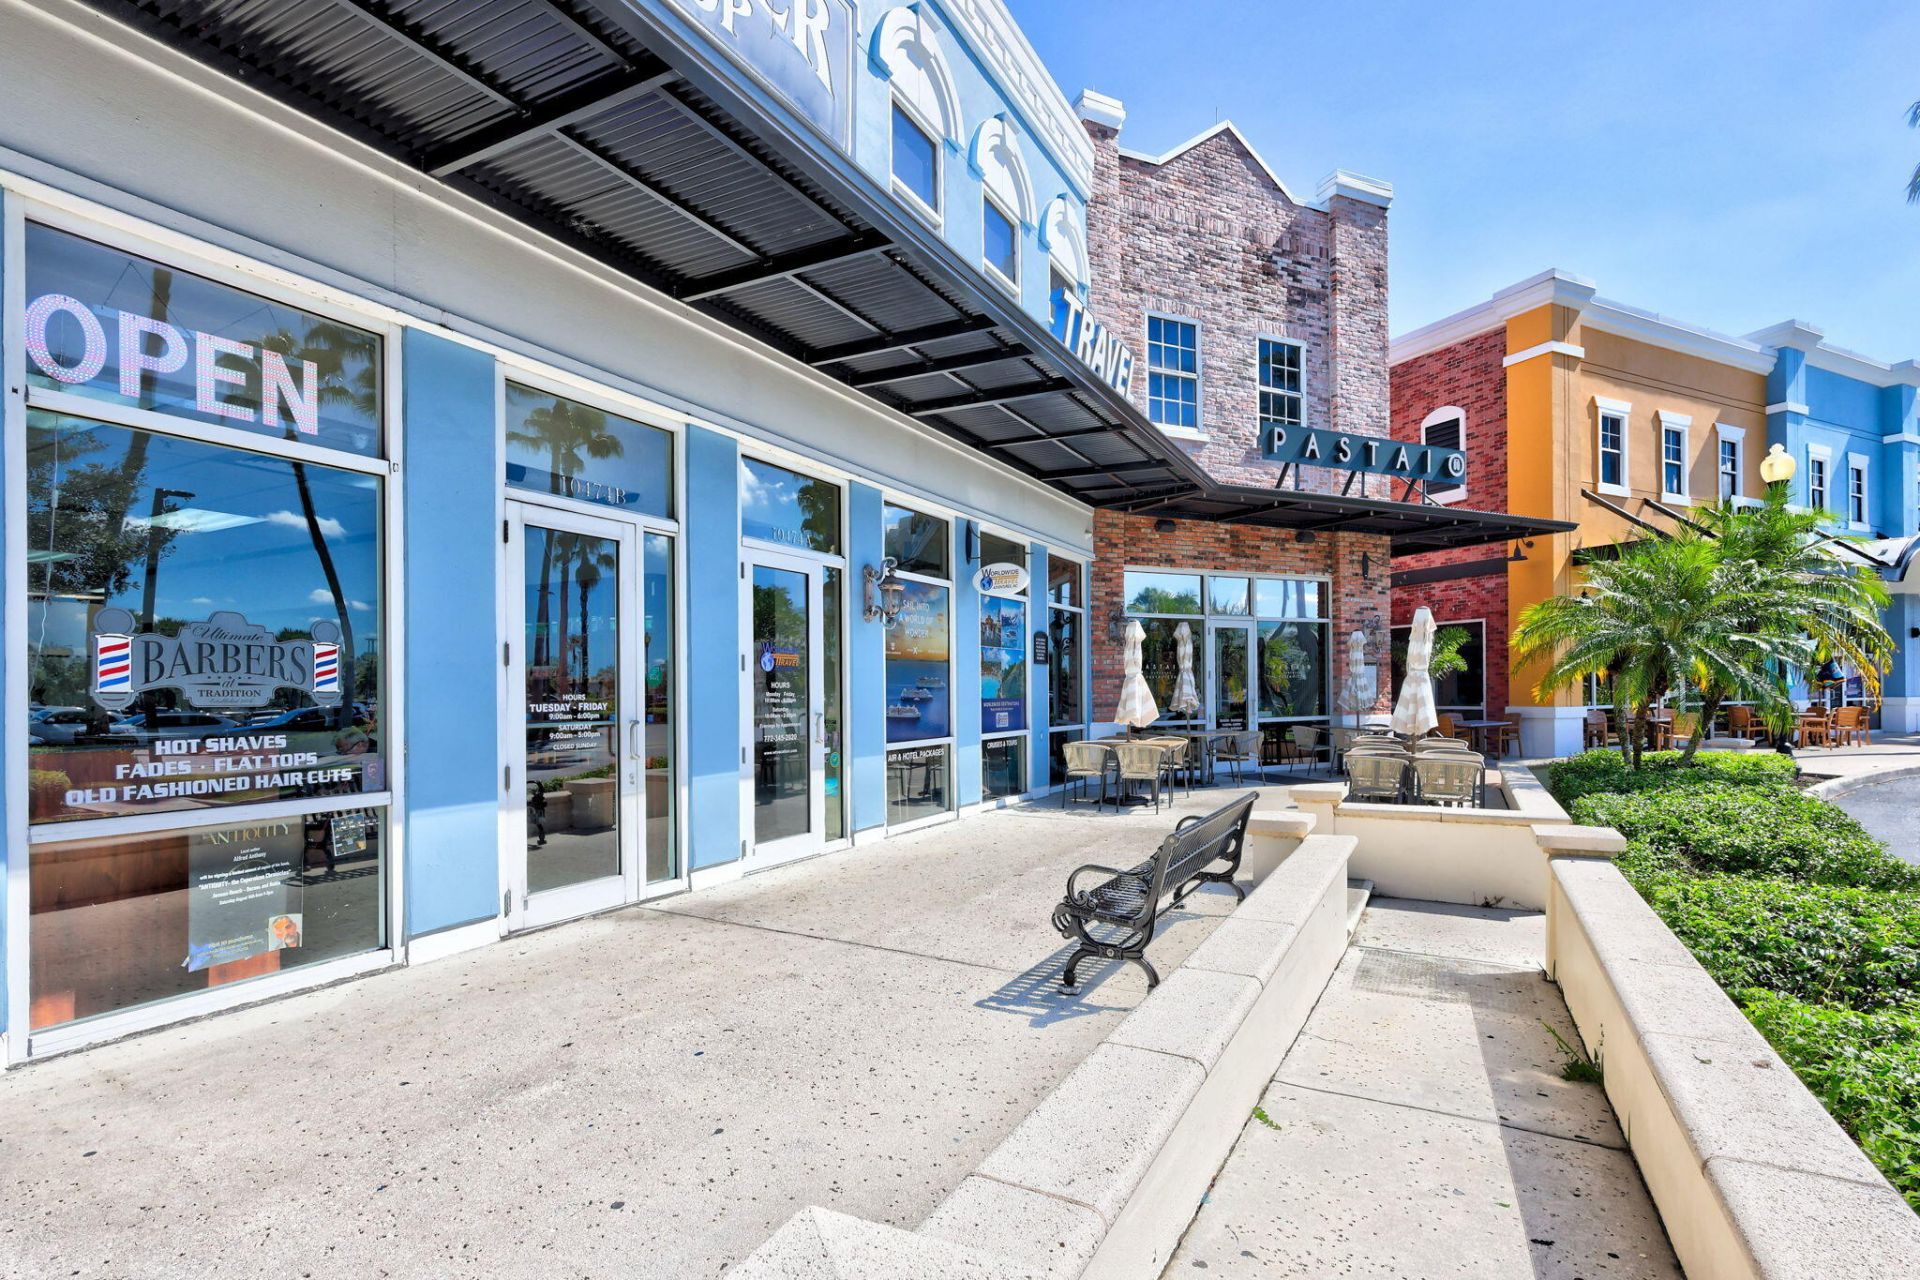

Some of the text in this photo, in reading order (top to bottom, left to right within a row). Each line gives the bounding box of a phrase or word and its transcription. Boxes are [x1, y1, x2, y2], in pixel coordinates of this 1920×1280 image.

[1061, 287, 1135, 404] TRAVEL
[25, 293, 319, 435] OPEN
[191, 624, 264, 641] Ultimate
[140, 640, 307, 685] BARBERS
[219, 679, 236, 688] at
[197, 689, 261, 698] TRADITION
[530, 703, 571, 712] TUESDAY
[578, 702, 608, 711] FRIDAY
[549, 732, 573, 740] 9:00am
[578, 731, 600, 739] 5:00pm
[558, 724, 592, 732] SATURDAY
[155, 735, 287, 755] HOT SHAVES
[888, 753, 897, 762] AIR
[903, 751, 919, 760] HOTEL
[920, 748, 944, 758] PACKAGES
[115, 752, 317, 779] FADES FLAT TOPS
[65, 768, 352, 806] OLD FASHIONED HAIR CUTS
[233, 852, 267, 862] Alfred Anthony
